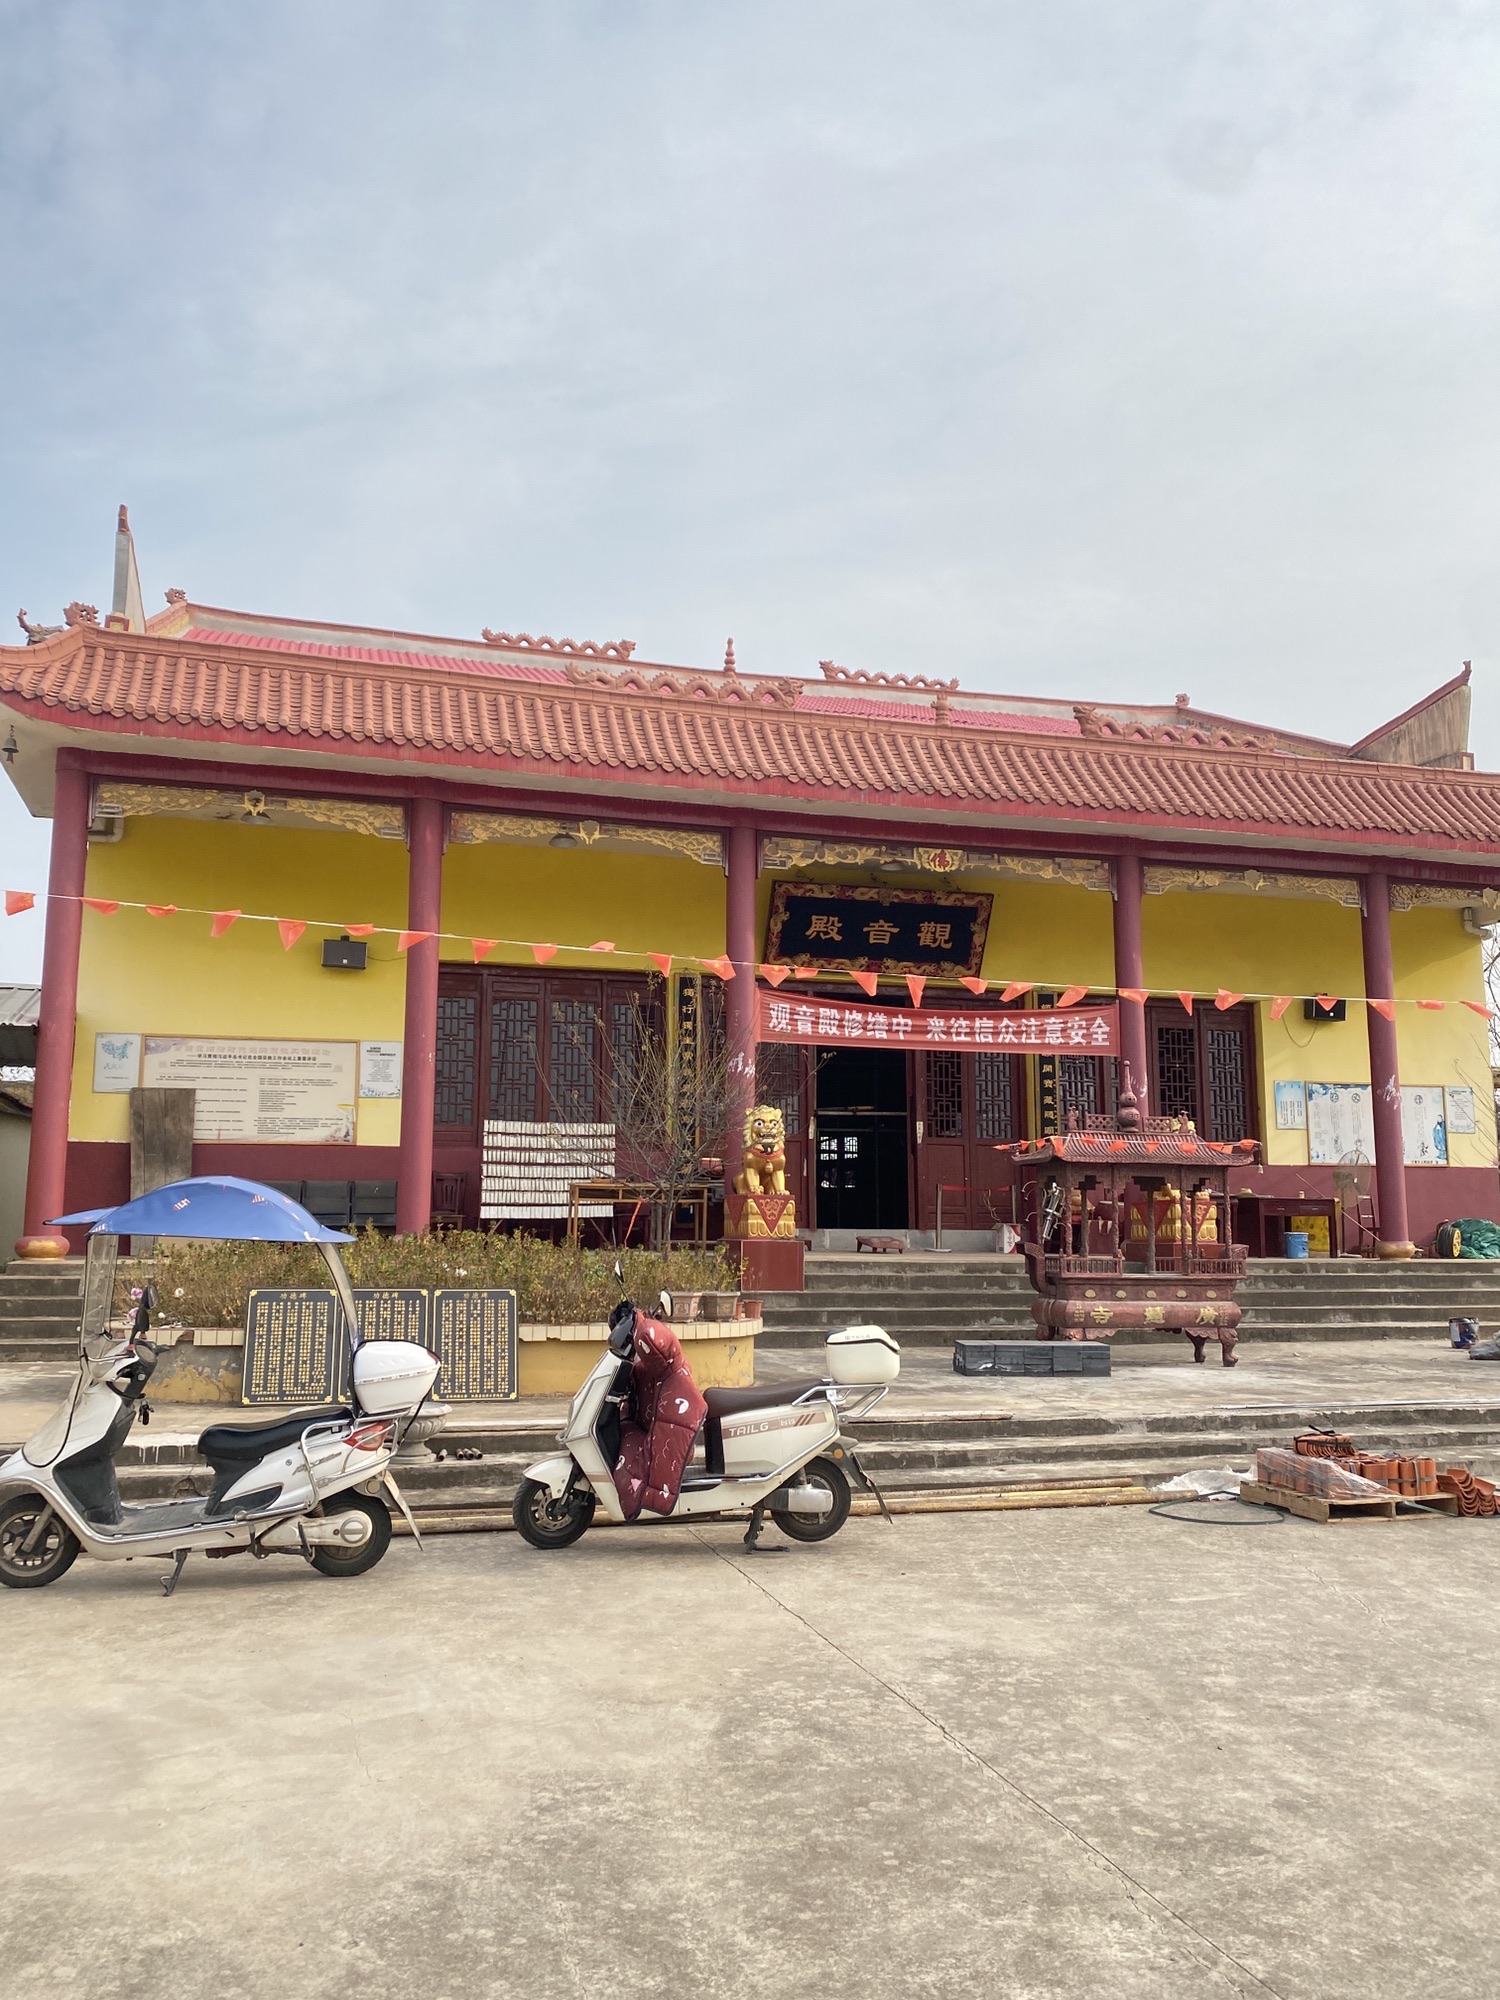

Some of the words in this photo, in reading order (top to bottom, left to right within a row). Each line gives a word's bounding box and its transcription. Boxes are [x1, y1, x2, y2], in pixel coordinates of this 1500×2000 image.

[804, 914, 954, 950] 觀音殿
[768, 1002, 913, 1041] 观音殿修缮中
[926, 1015, 1111, 1047] 来往信众注意安全
[279, 1291, 308, 1300] 功德碑
[372, 1291, 399, 1300] 功德碑
[462, 1291, 489, 1300] 功德碑
[728, 1422, 769, 1437] TAILG
